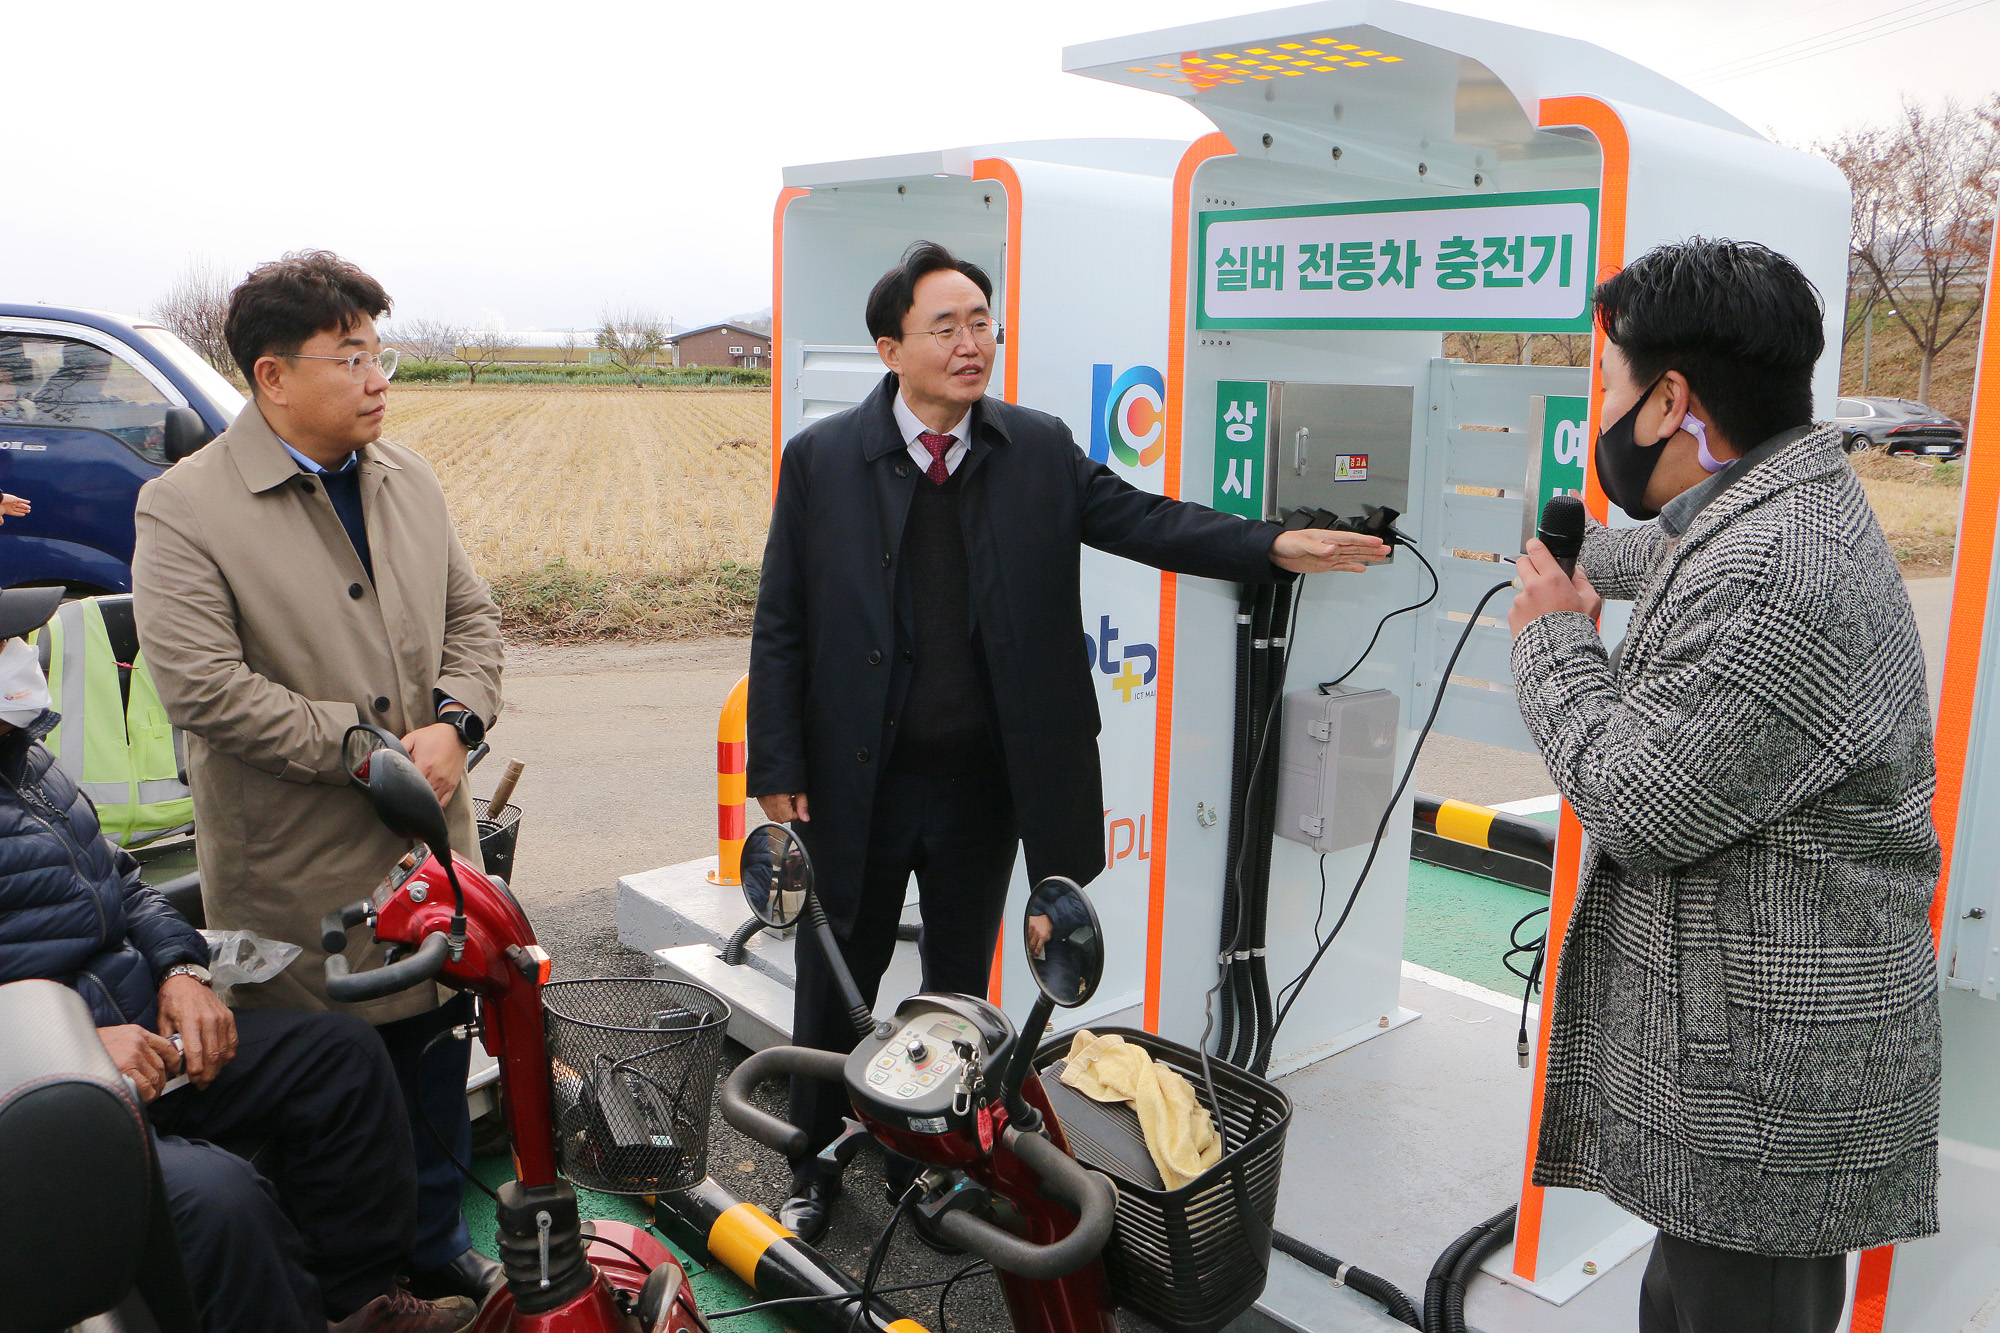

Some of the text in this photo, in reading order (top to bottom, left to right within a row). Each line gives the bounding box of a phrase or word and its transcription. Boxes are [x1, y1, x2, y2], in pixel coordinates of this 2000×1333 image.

[1215, 234, 1572, 292] 실버 전동차 충전기
